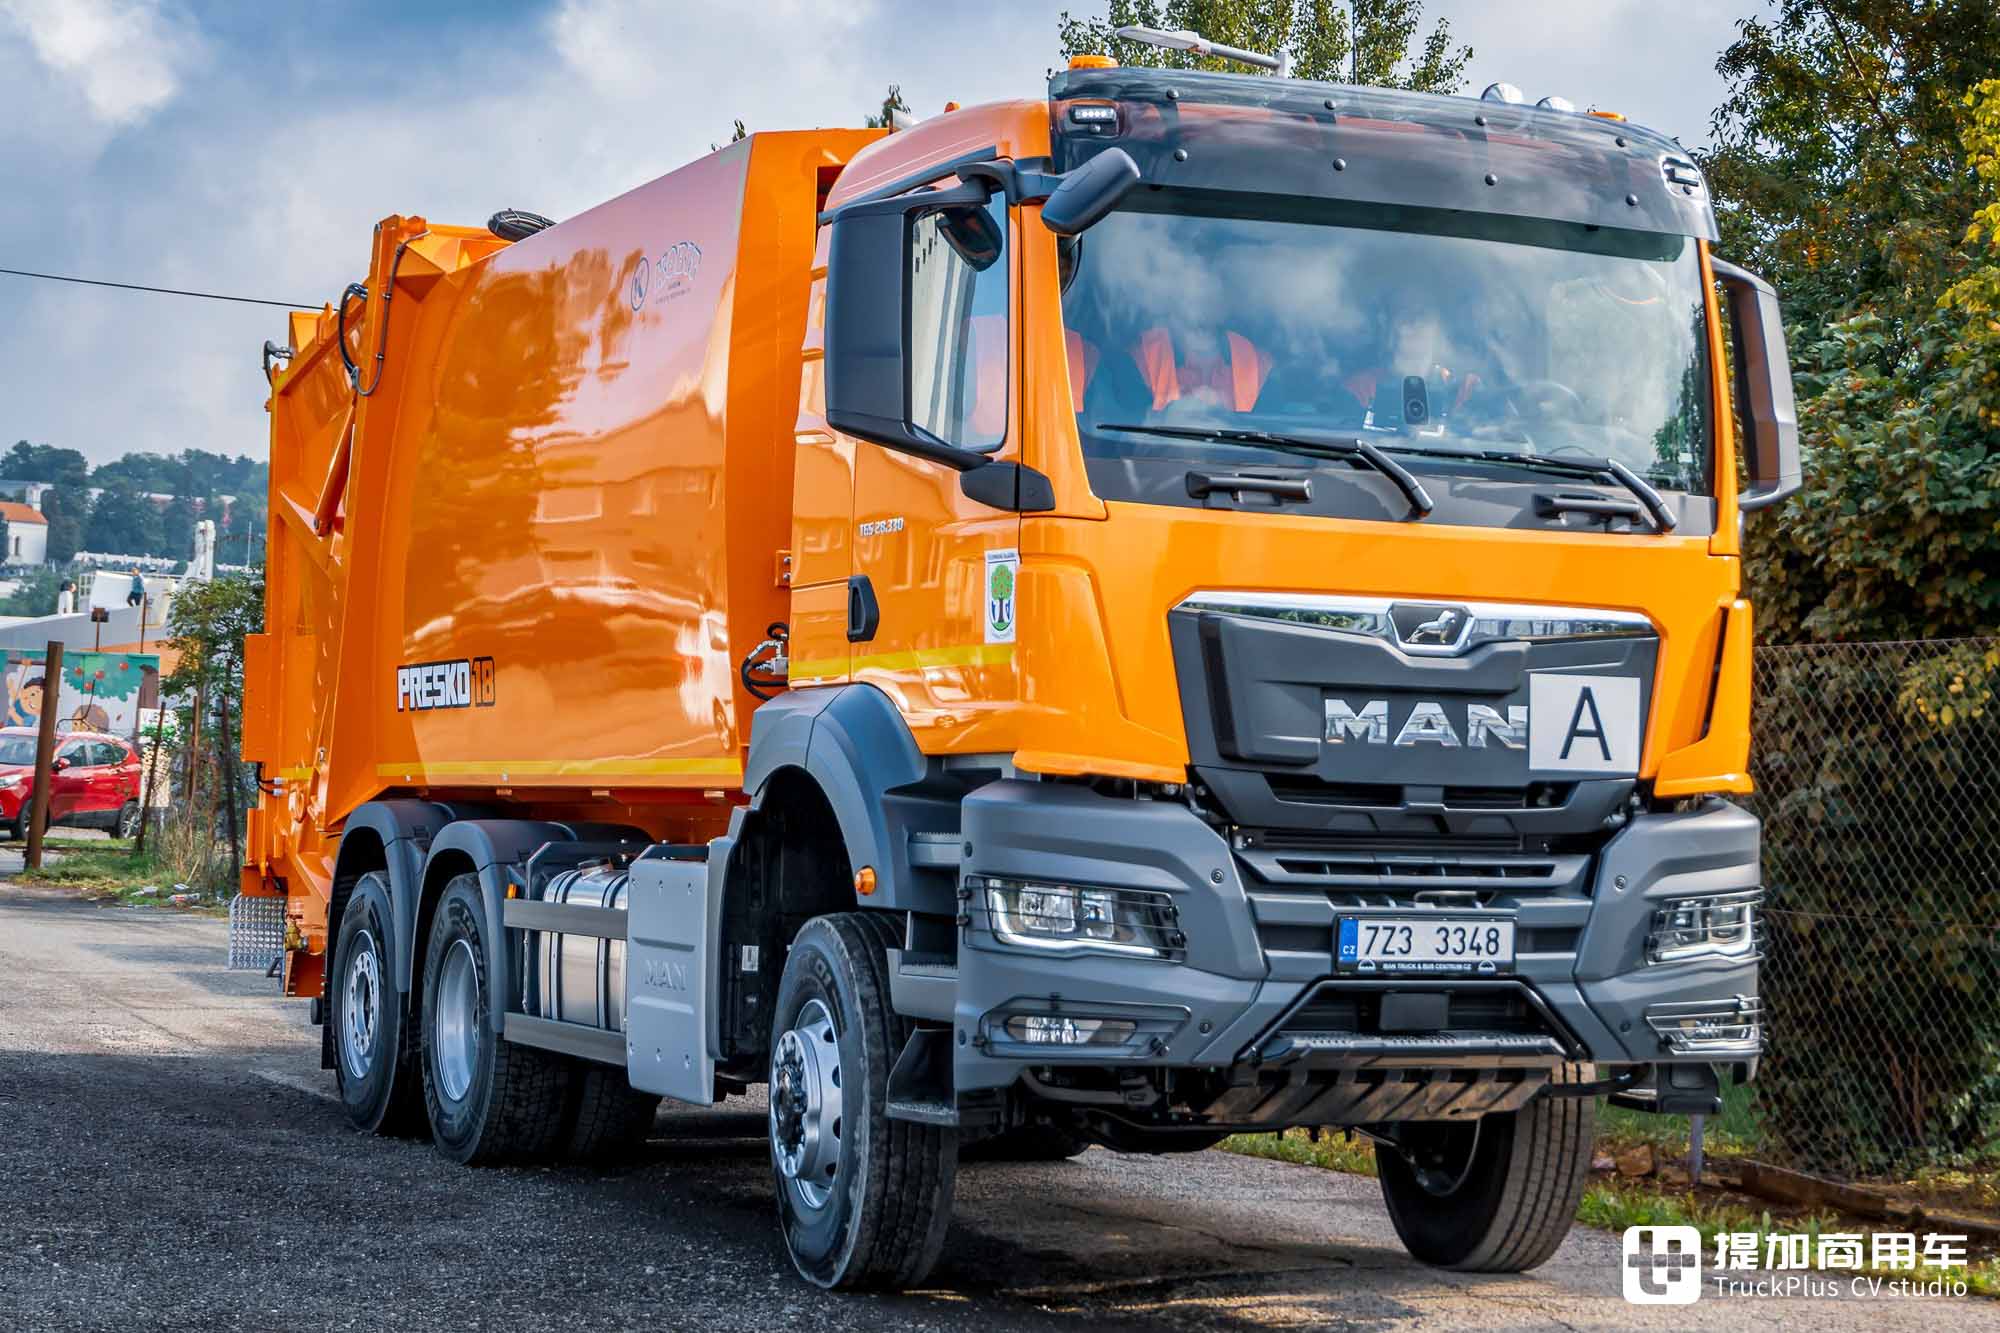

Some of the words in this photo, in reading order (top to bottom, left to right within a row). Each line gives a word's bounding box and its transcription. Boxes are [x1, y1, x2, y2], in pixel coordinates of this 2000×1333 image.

[397, 659, 471, 712] PRESKO
[472, 656, 496, 707] 18
[1325, 698, 1528, 748] MAN
[1559, 686, 1612, 760] A
[1342, 945, 1356, 954] CZ
[1365, 925, 1413, 955] 7Z3
[1435, 926, 1500, 955] 3348
[644, 958, 688, 992] MAN
